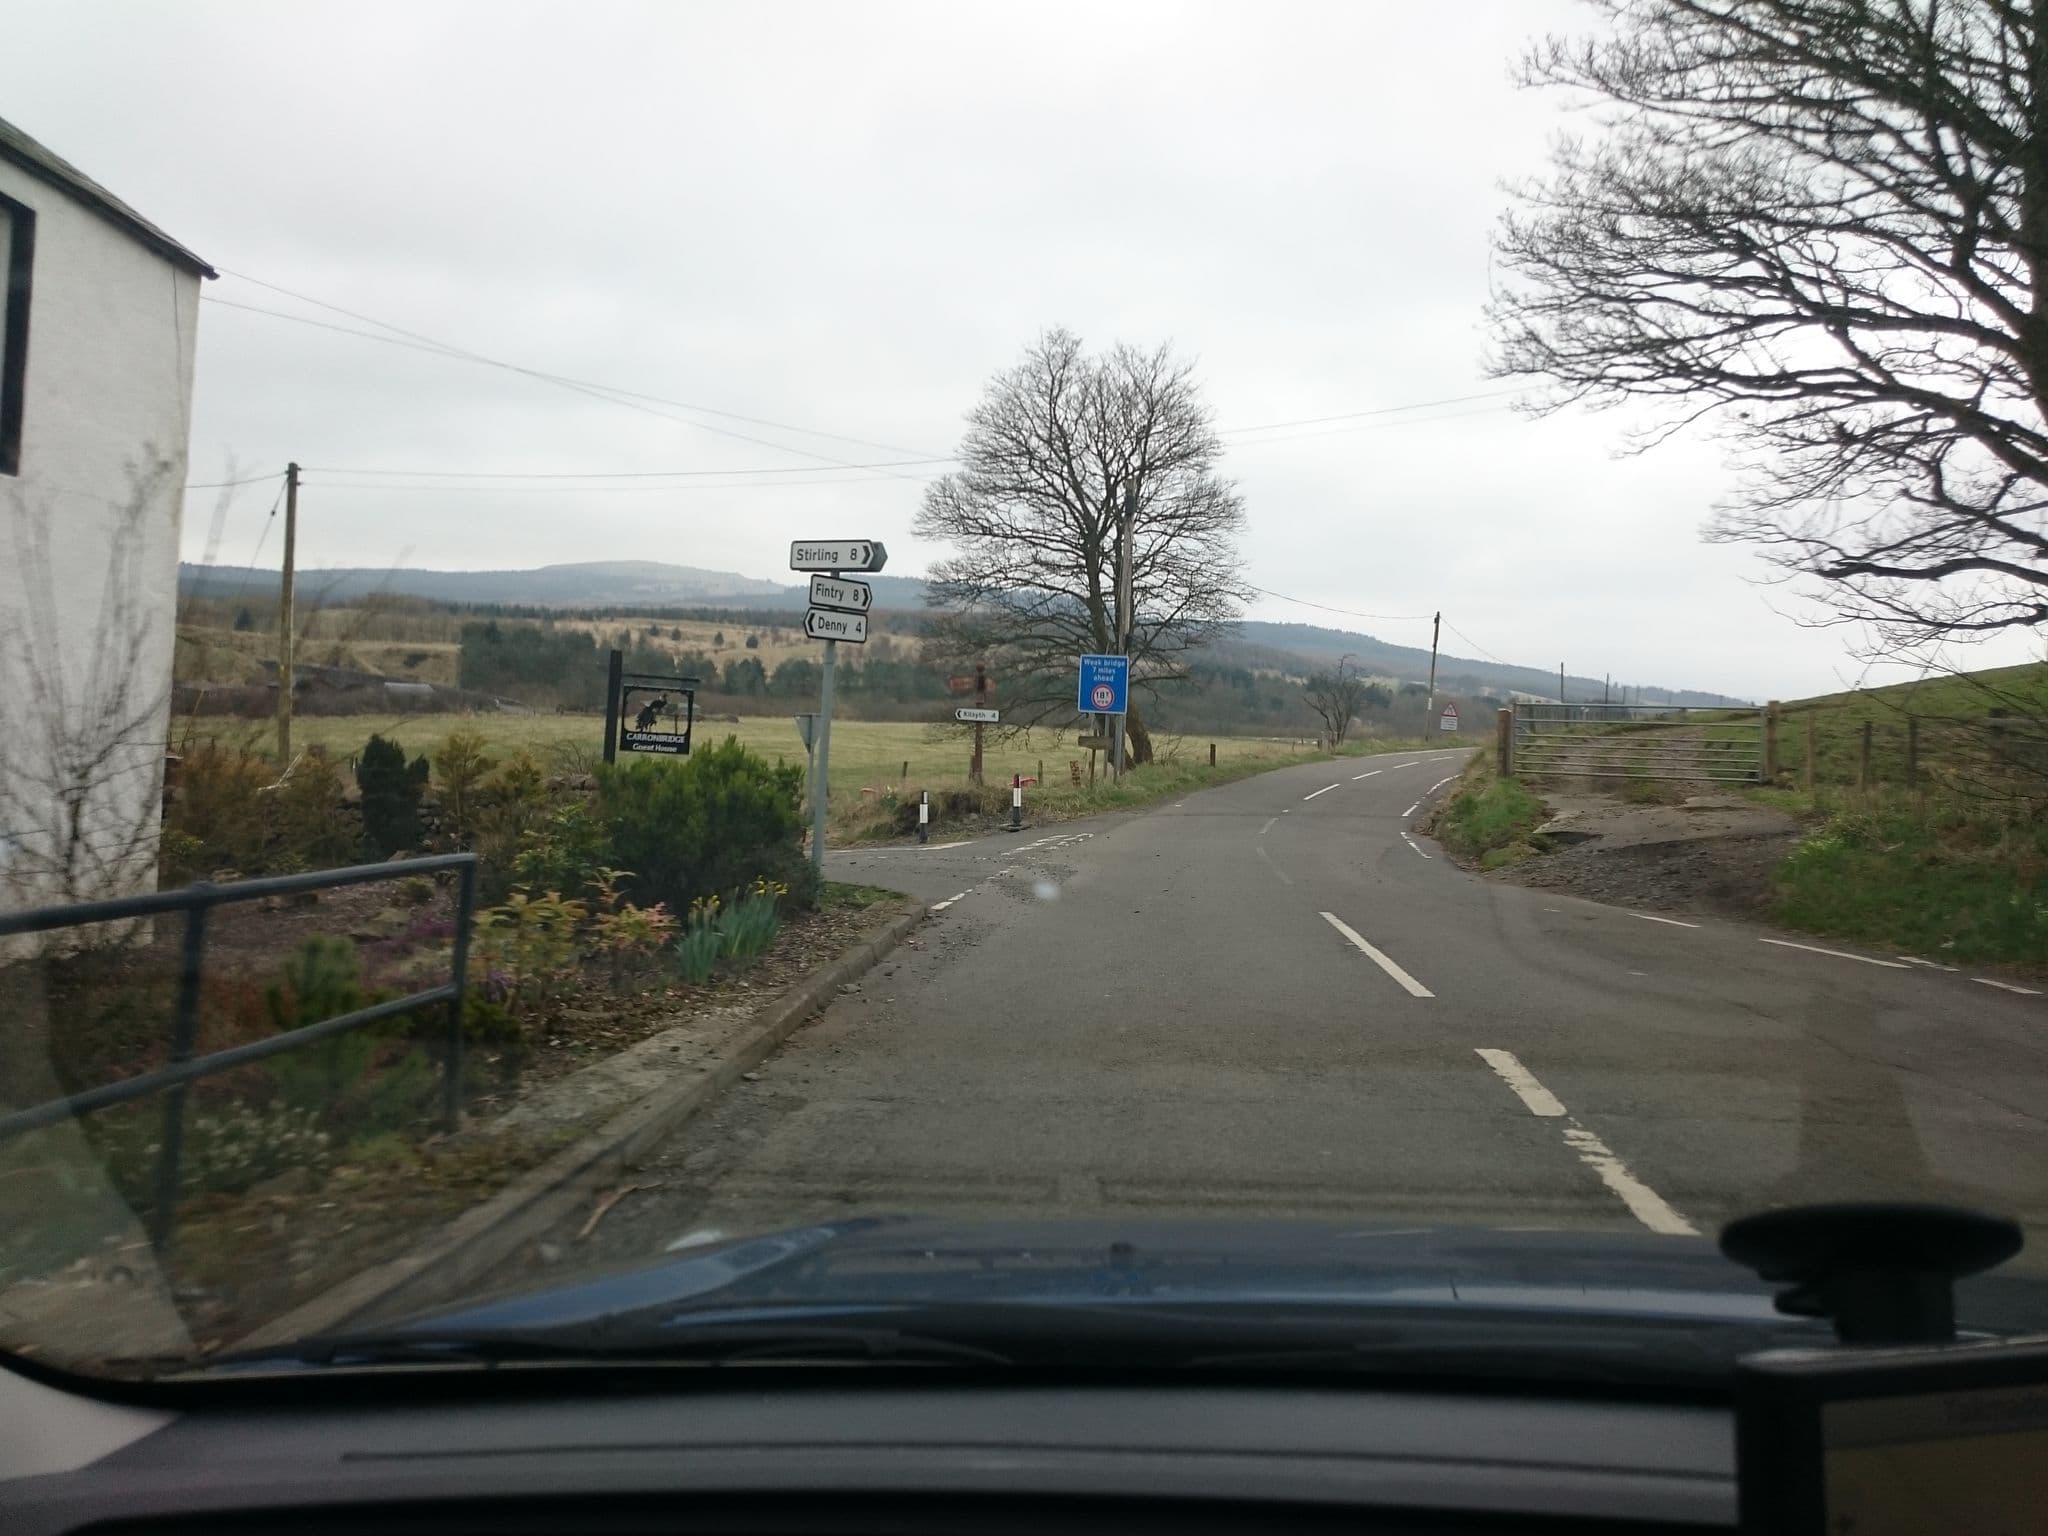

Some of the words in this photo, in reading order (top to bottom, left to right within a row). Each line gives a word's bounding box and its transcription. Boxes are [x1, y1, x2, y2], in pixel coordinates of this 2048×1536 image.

[796, 548, 839, 563] Stirling
[850, 548, 858, 561] 8
[815, 582, 844, 602] Fintry
[853, 589, 859, 602] 8
[818, 616, 847, 634] Denny
[856, 621, 862, 633] 4
[1104, 660, 1125, 668] bridge
[632, 743, 655, 751] Guest
[656, 744, 677, 752] House
